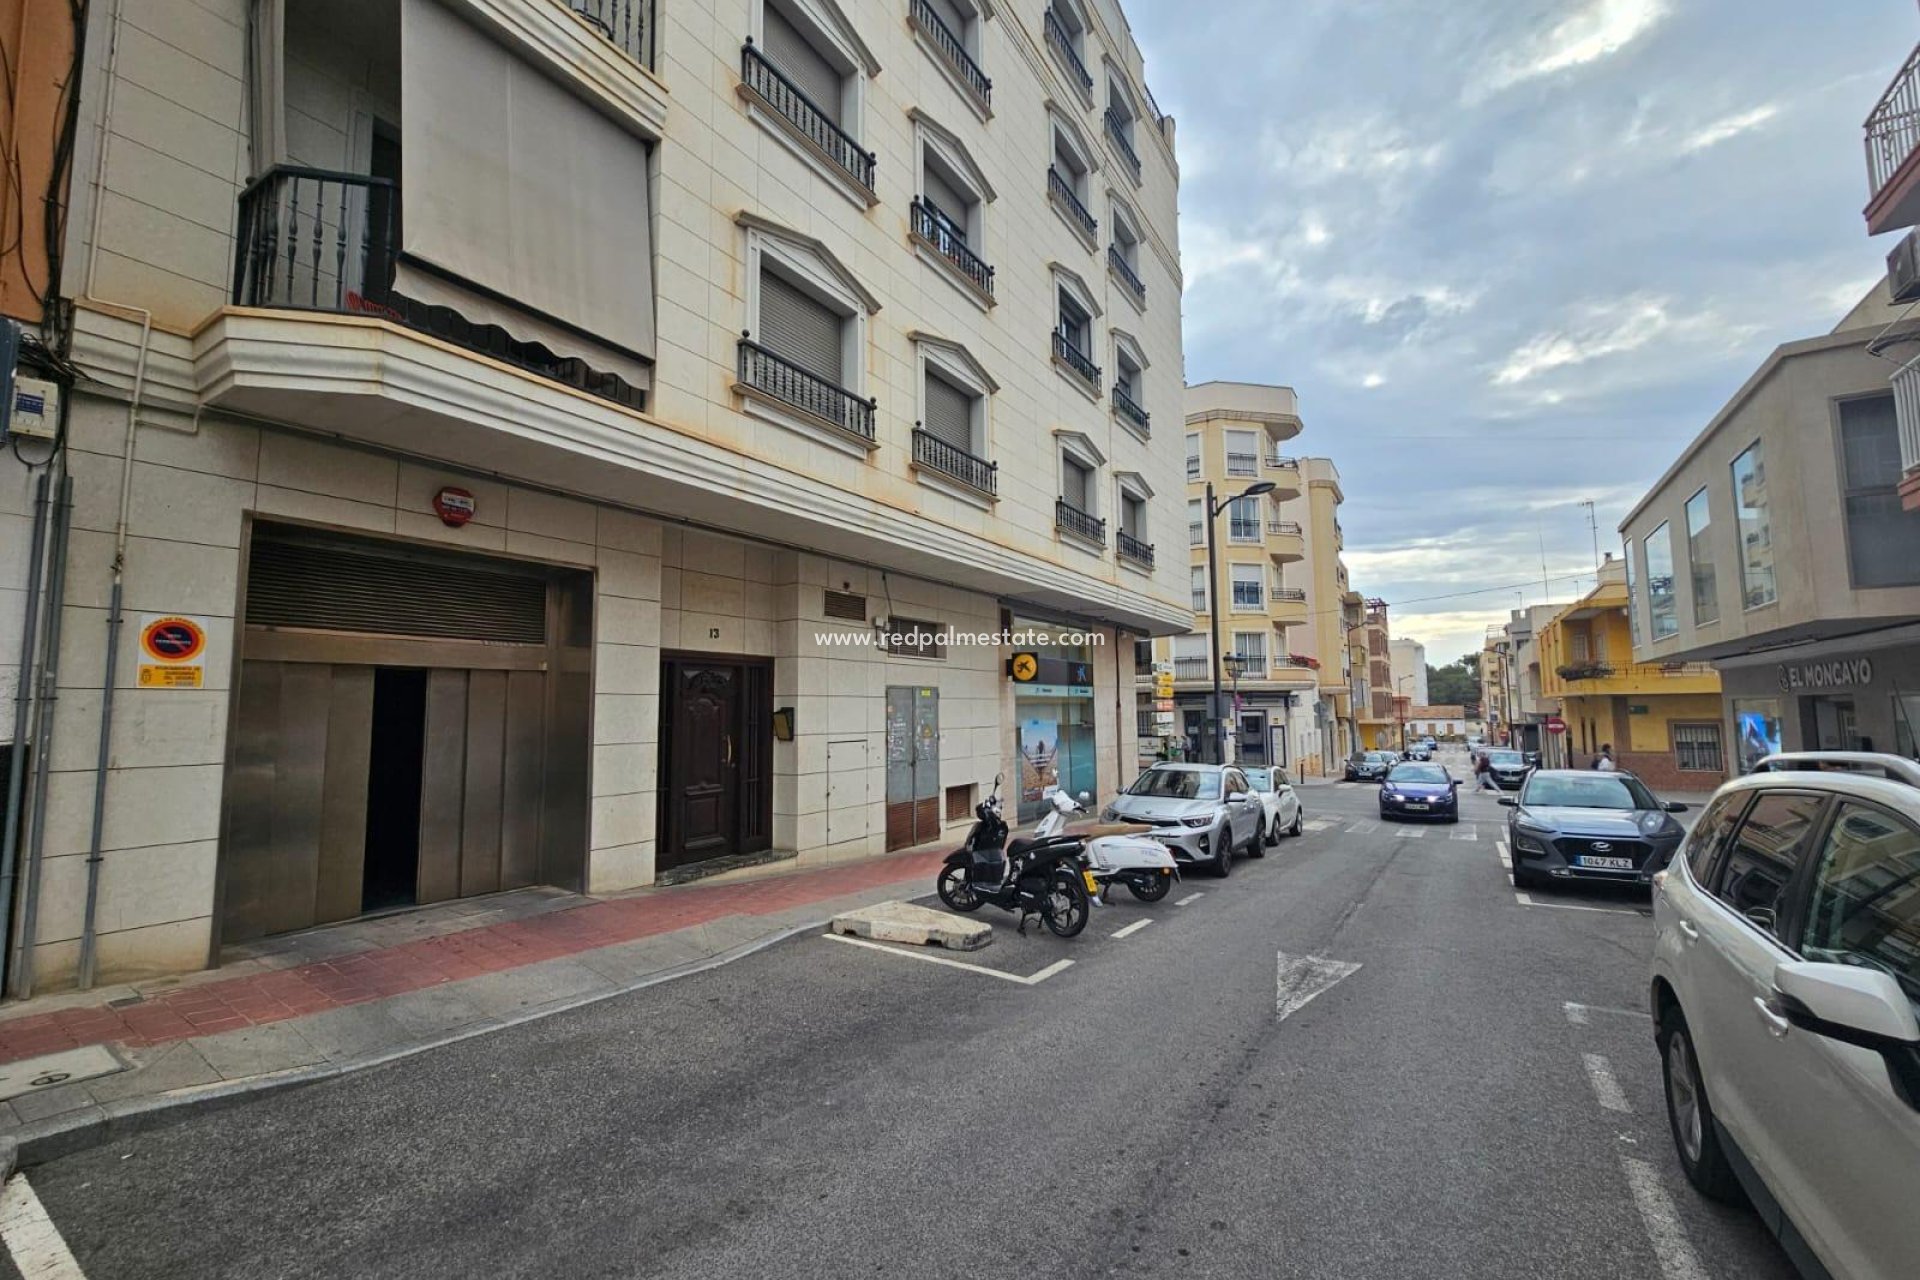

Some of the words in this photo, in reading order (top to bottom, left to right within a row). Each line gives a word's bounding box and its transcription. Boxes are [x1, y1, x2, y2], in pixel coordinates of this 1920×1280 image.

[709, 628, 720, 639] 13
[1789, 667, 1803, 687] EL
[1805, 658, 1872, 688] MONCAYO
[1583, 856, 1606, 866] 1047
[1609, 857, 1629, 868] KLZ
